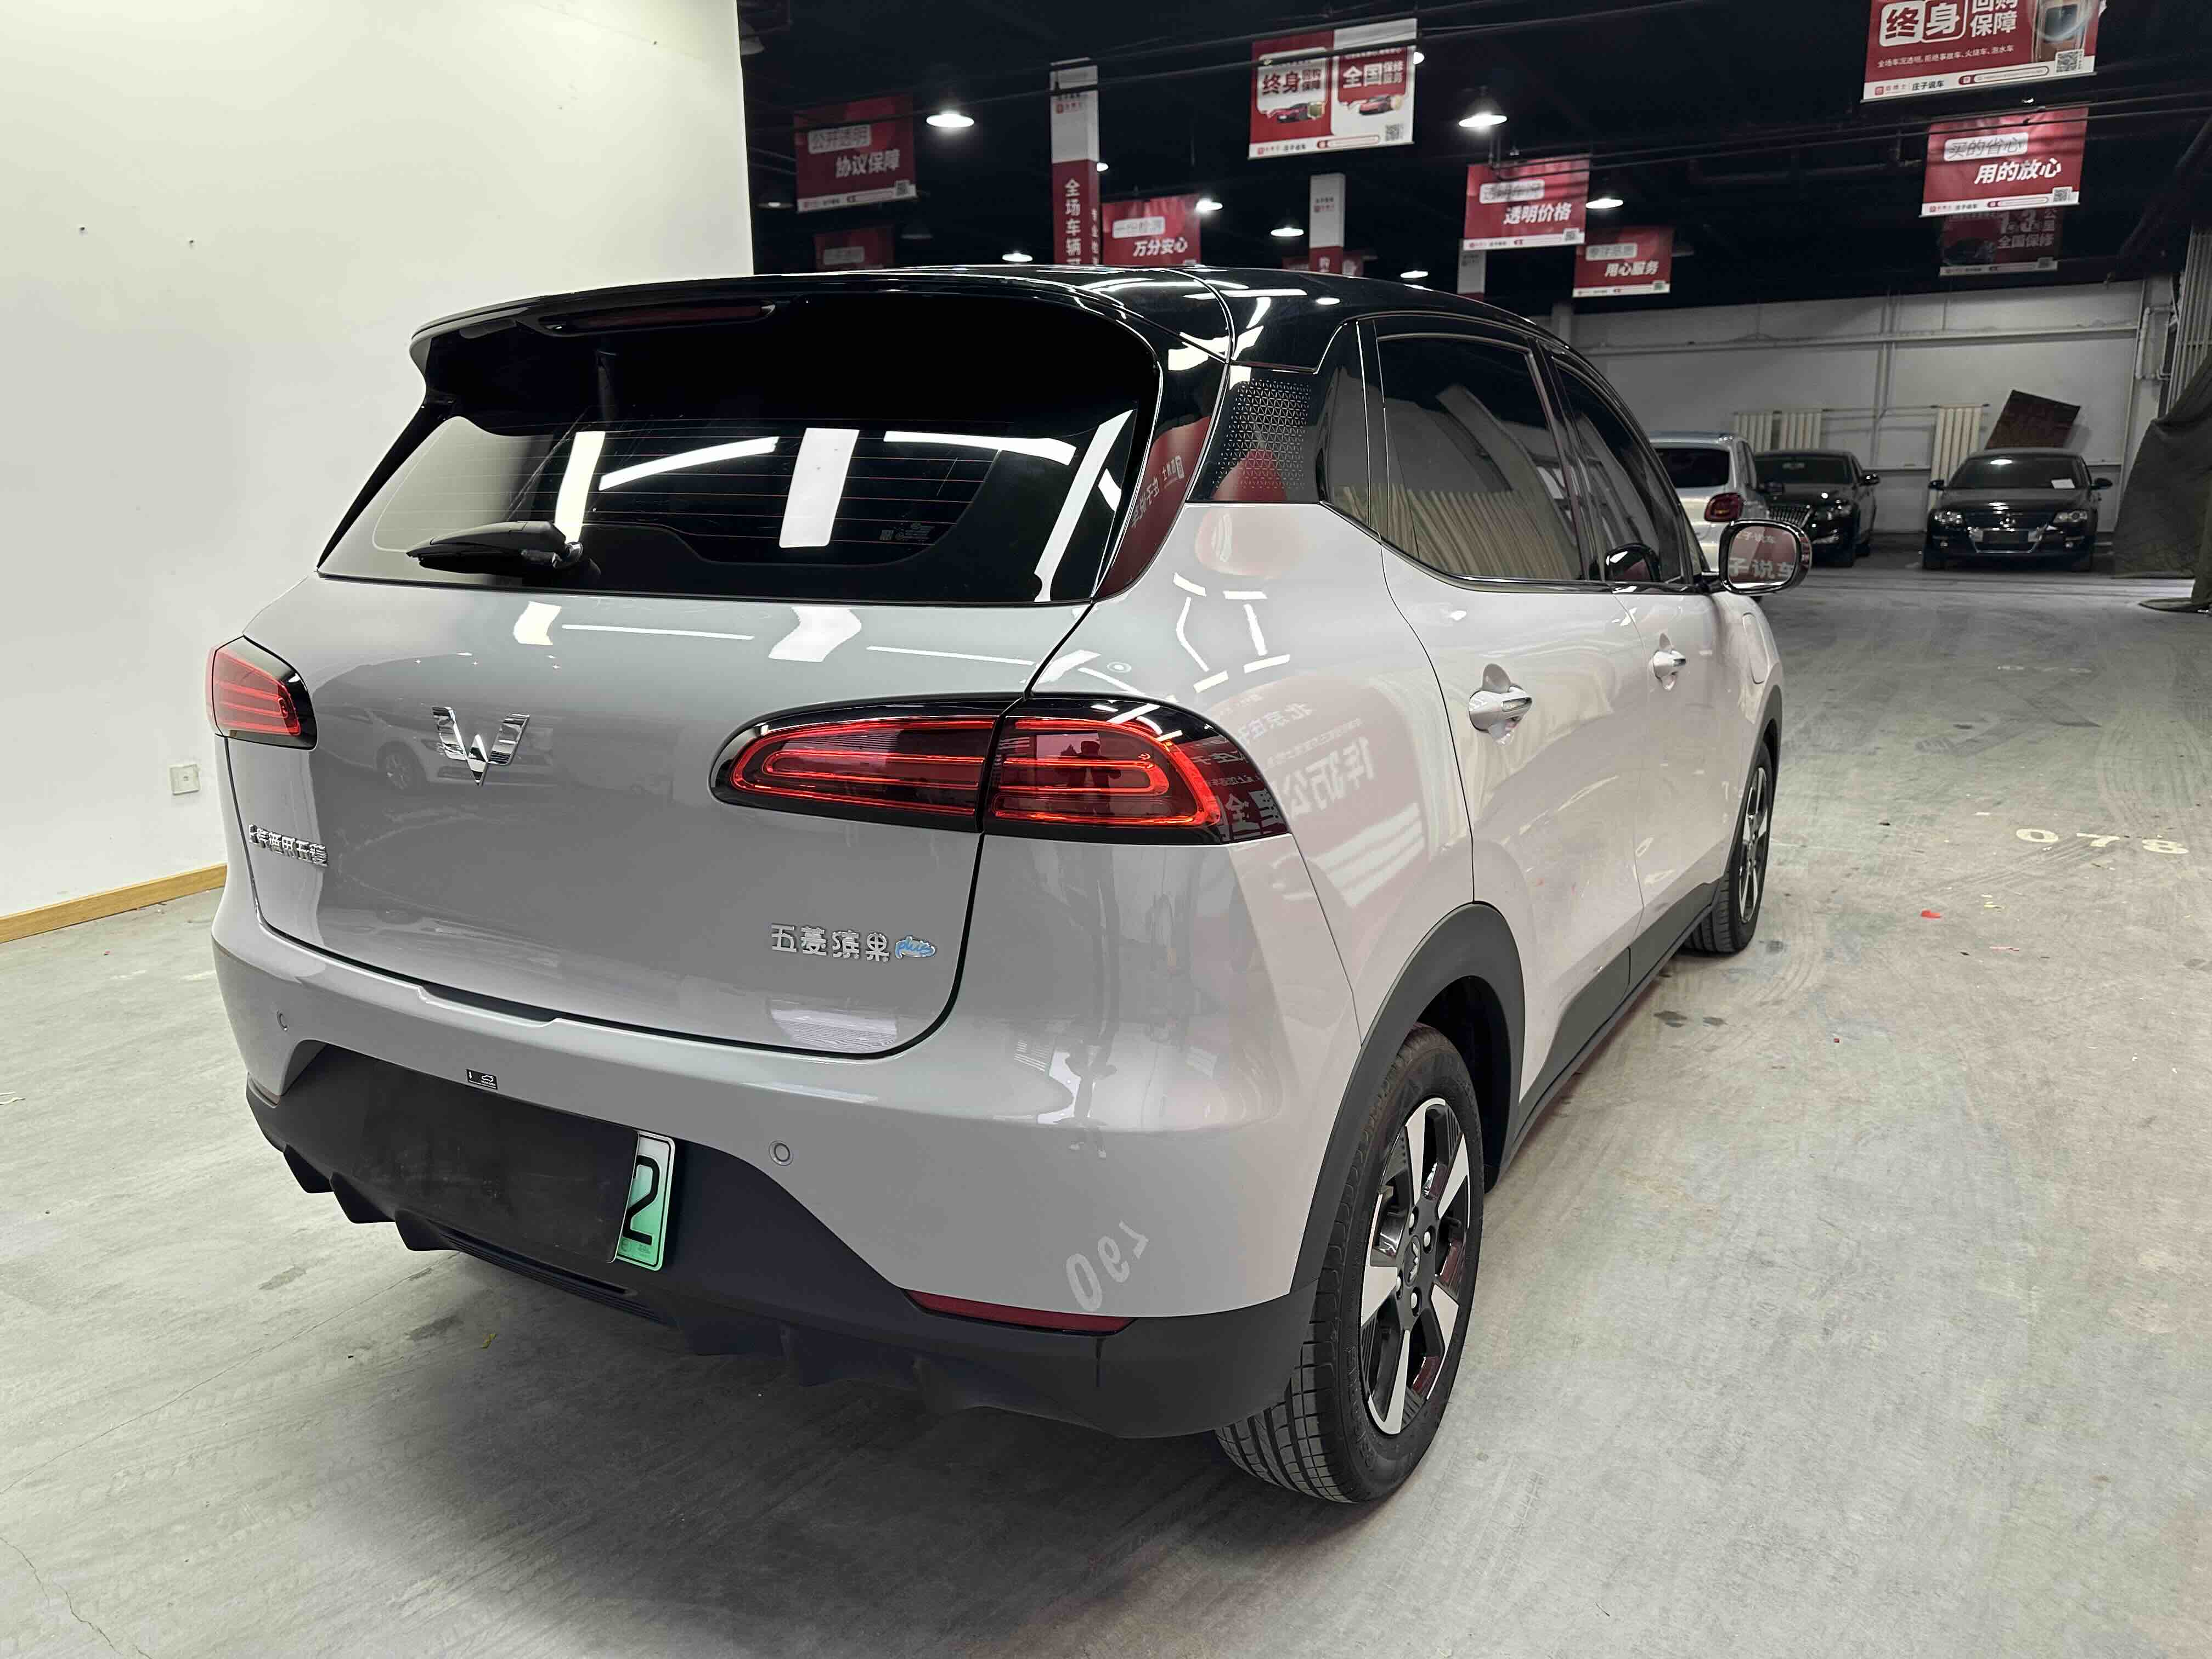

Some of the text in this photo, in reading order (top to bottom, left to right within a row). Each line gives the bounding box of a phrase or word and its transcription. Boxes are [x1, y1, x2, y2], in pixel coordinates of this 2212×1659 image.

[1885, 3, 1960, 40] 终身
[1970, 11, 2018, 38] 保障
[1262, 71, 1301, 94] 终身
[1342, 63, 1383, 88] 全国
[1946, 137, 2025, 159] 买的省心
[836, 149, 900, 179] 协议保障
[1974, 158, 2062, 185] 用的放心
[1503, 202, 1572, 224] 透明价格
[1133, 237, 1188, 257] 万分安心
[1604, 261, 1659, 278] 用心服务
[2016, 828, 2189, 854] 078
[771, 922, 890, 963] 五菱缤果
